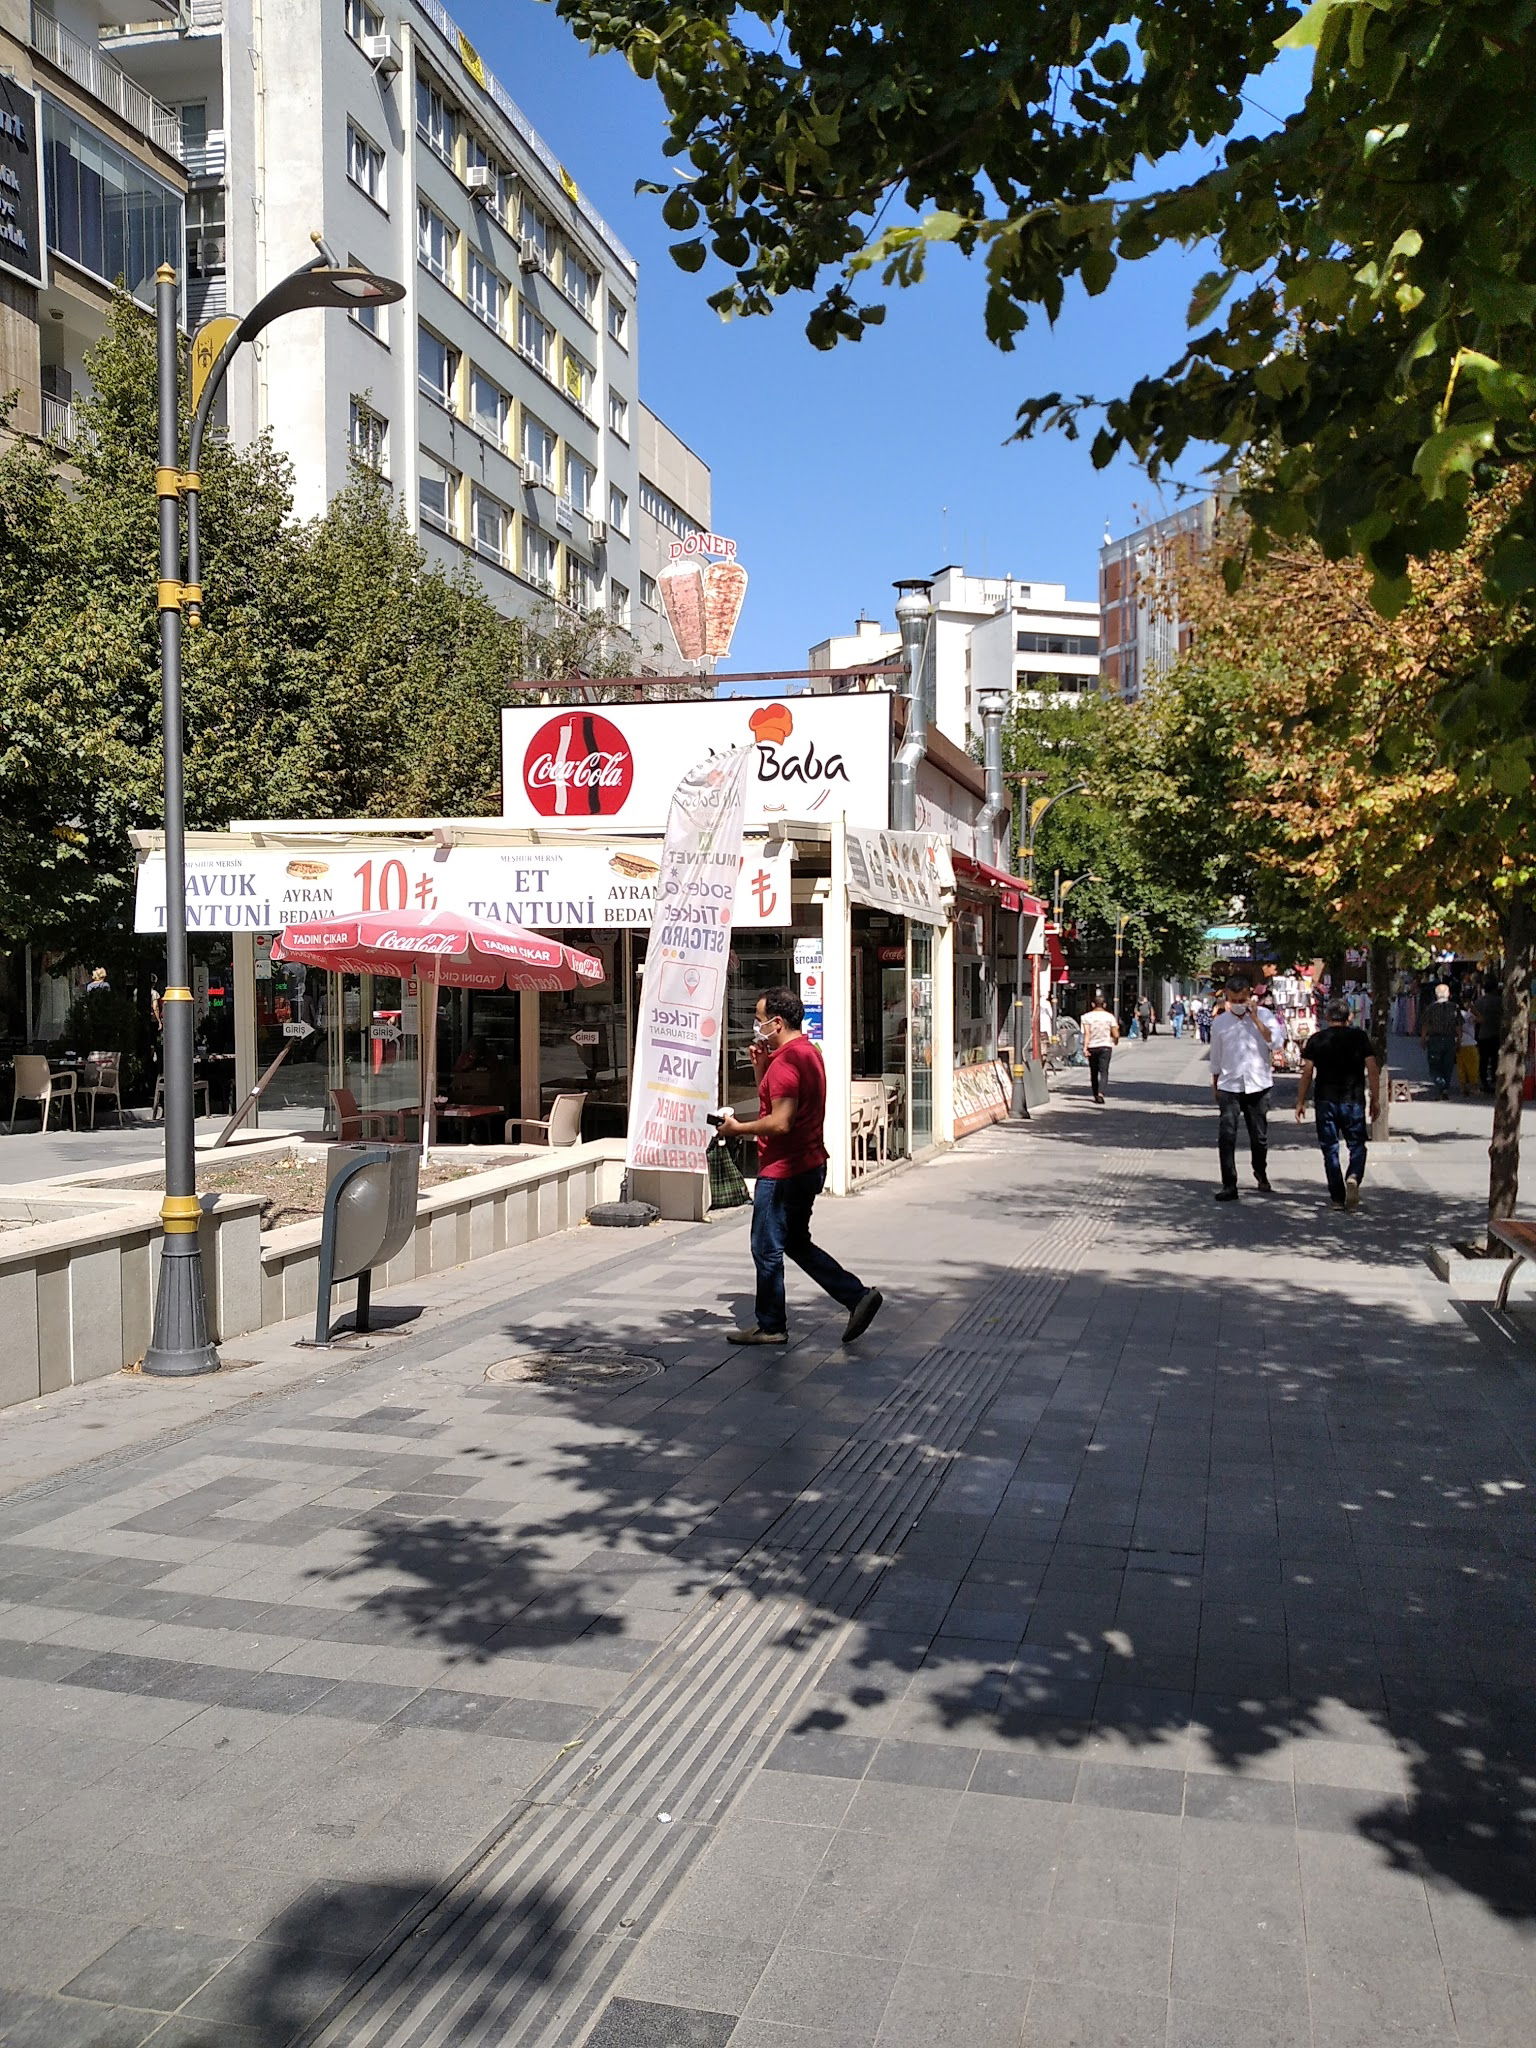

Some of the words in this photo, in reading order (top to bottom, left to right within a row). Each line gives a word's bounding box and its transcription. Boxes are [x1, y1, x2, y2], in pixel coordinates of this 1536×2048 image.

[670, 531, 736, 559] DÖNER
[527, 750, 629, 789] Coca-Cola
[756, 741, 850, 784] Baba
[185, 874, 257, 896] AVUK
[353, 859, 408, 910] 10
[515, 870, 549, 893] ET
[283, 889, 333, 902] AYRAN
[155, 899, 270, 927] TNTUNİ
[468, 896, 594, 925] TANTUNİ
[604, 908, 653, 922] BEDAV
[293, 934, 321, 945] TADINI
[323, 934, 348, 946] ÇIKAR
[376, 929, 460, 952] Coca-Cola
[483, 939, 517, 955] TADINI
[519, 946, 550, 961] ÇIKAR
[795, 956, 822, 965] SETCARD
[286, 1024, 306, 1034] GİRİŞ
[372, 1027, 394, 1037] GİRİŞ
[575, 1033, 596, 1042] GİRİŞ
